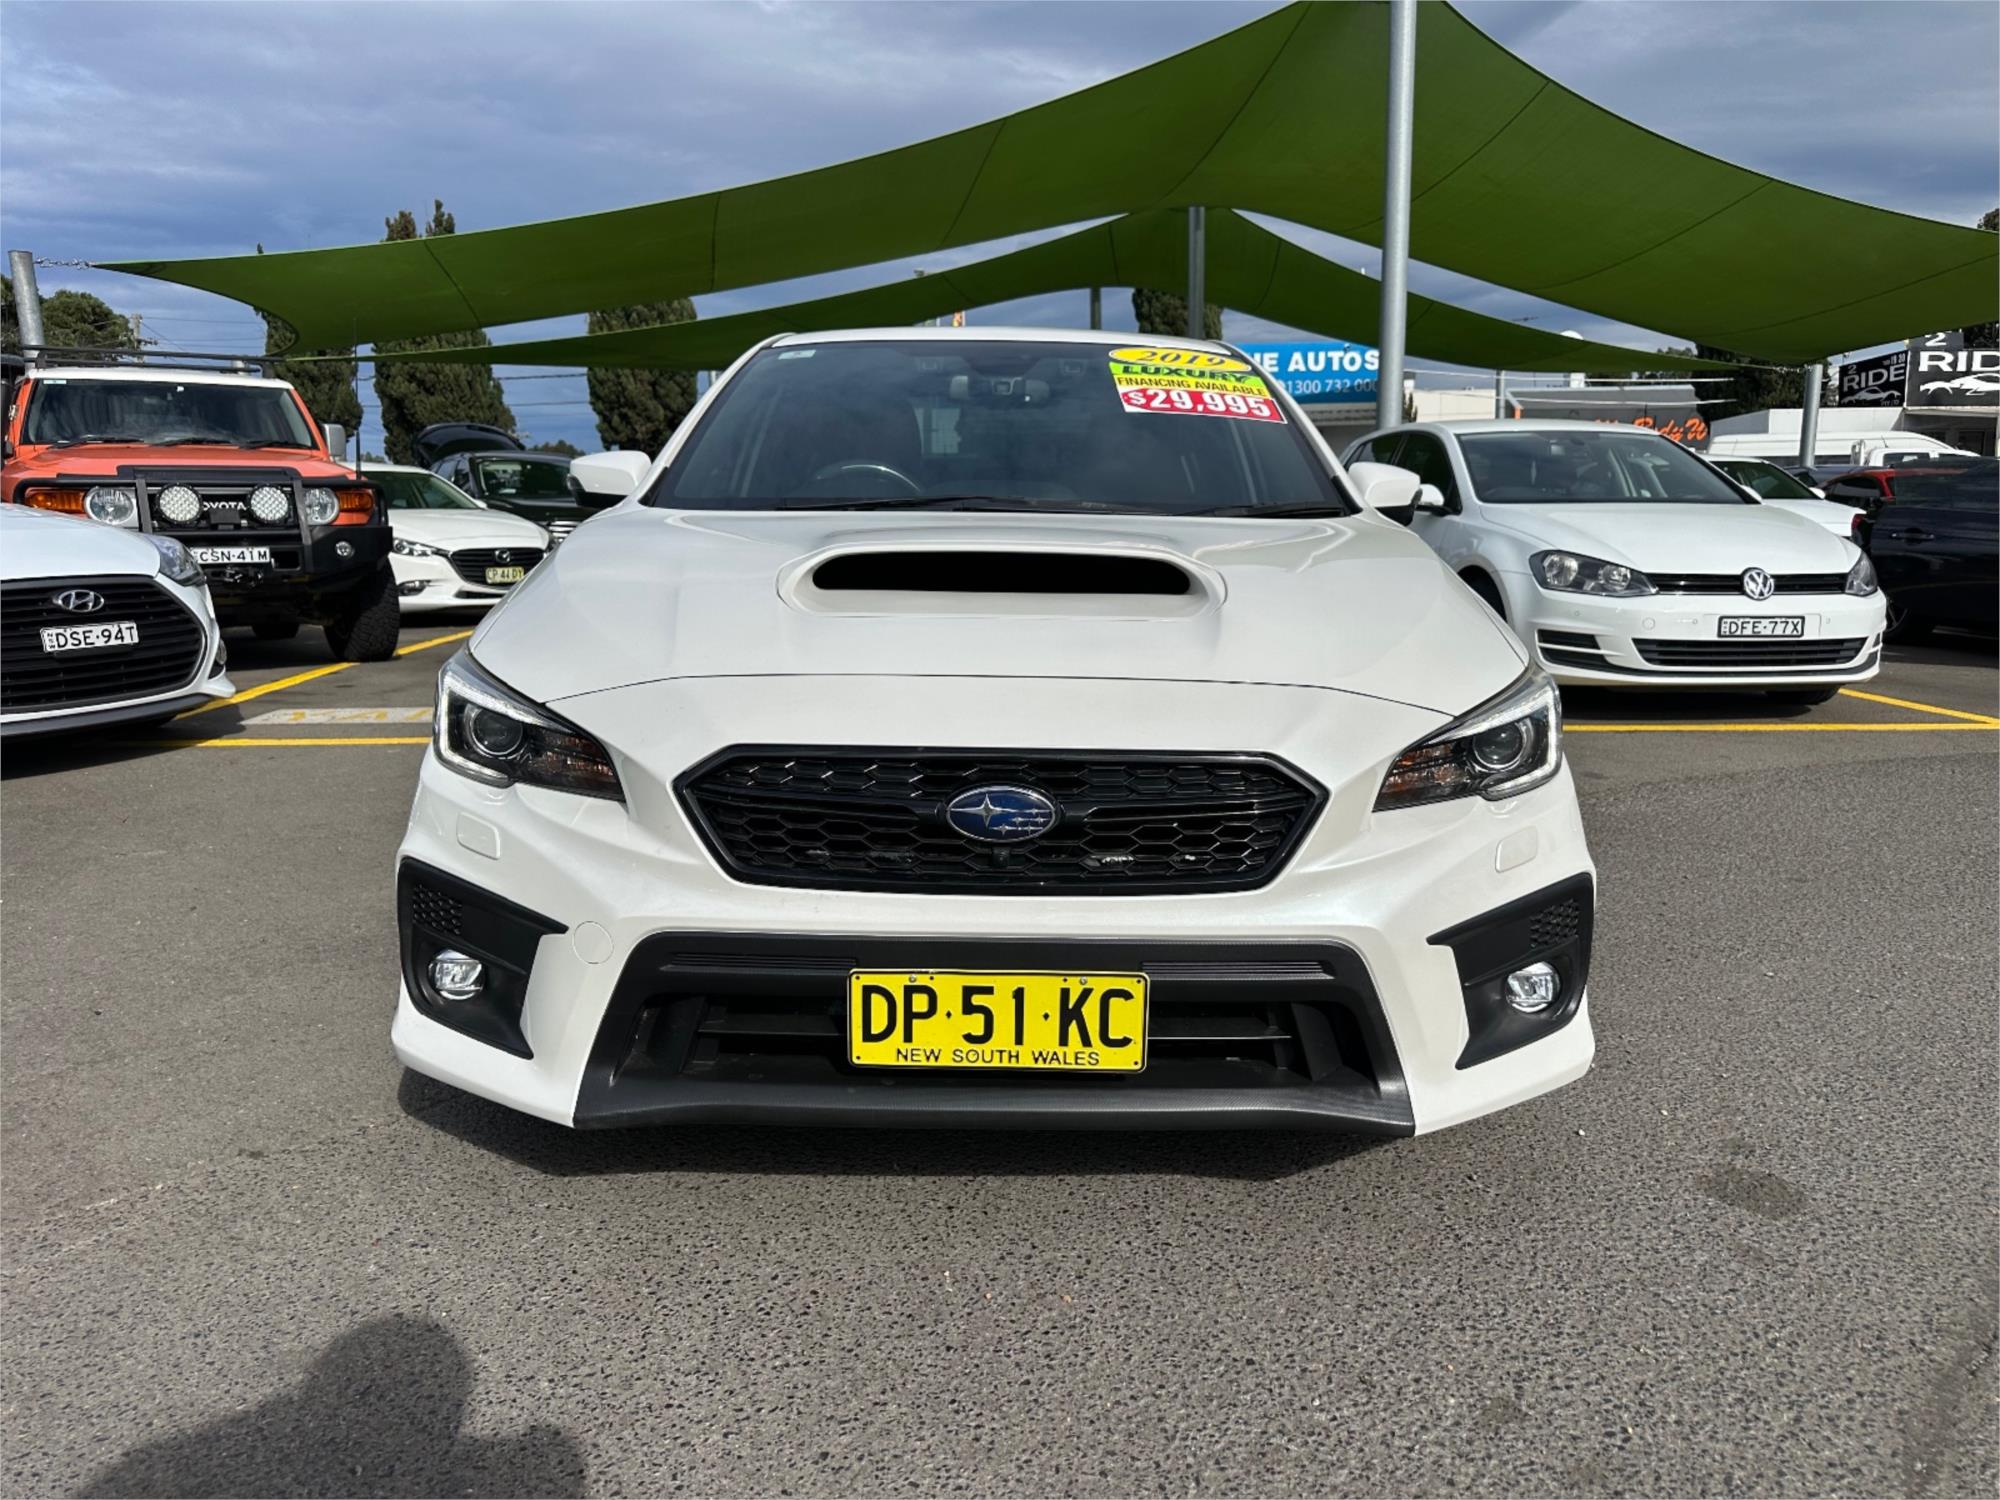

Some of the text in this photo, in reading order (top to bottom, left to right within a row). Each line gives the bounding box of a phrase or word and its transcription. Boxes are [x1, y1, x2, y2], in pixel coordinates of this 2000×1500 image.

[1924, 332, 1947, 347] 2
[1137, 350, 1226, 367] 2019
[1287, 351, 1380, 372] AUTOS
[1122, 365, 1247, 383] LUXURY
[1843, 364, 1906, 393] RIDE
[1847, 364, 1857, 375] 2
[1118, 377, 1266, 397] FINANCING AVAILABLE
[1325, 379, 1350, 393] 732
[1128, 388, 1272, 417] $29,995
[896, 1048, 1100, 1066] NEW SOUTH WALES
